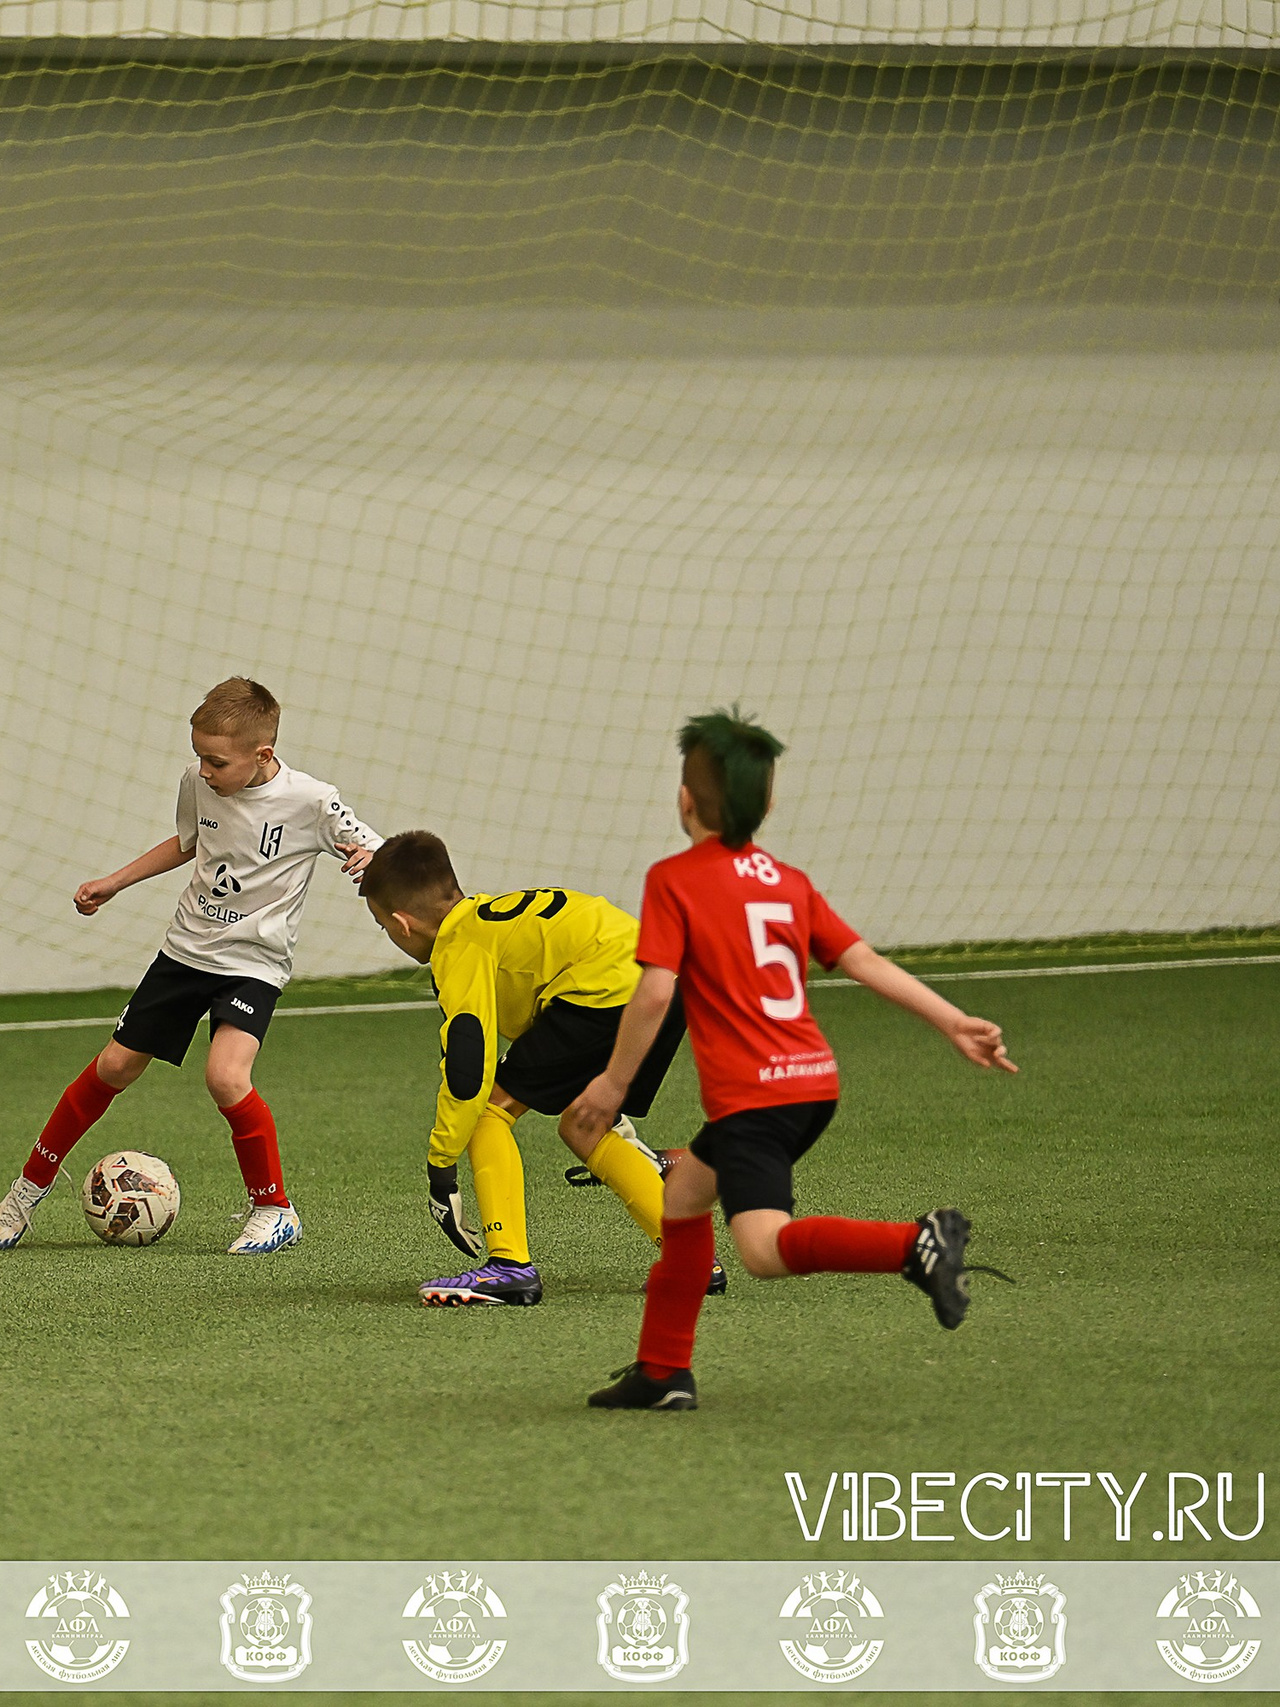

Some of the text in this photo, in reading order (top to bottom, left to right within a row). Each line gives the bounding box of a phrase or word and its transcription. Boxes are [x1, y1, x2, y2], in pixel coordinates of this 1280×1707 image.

[199, 817, 218, 830] JAKO
[744, 902, 804, 1021] 5
[230, 997, 255, 1015] JAKO
[35, 1139, 58, 1163] AKO
[246, 1183, 277, 1196] AKO
[483, 1221, 503, 1234] AKO
